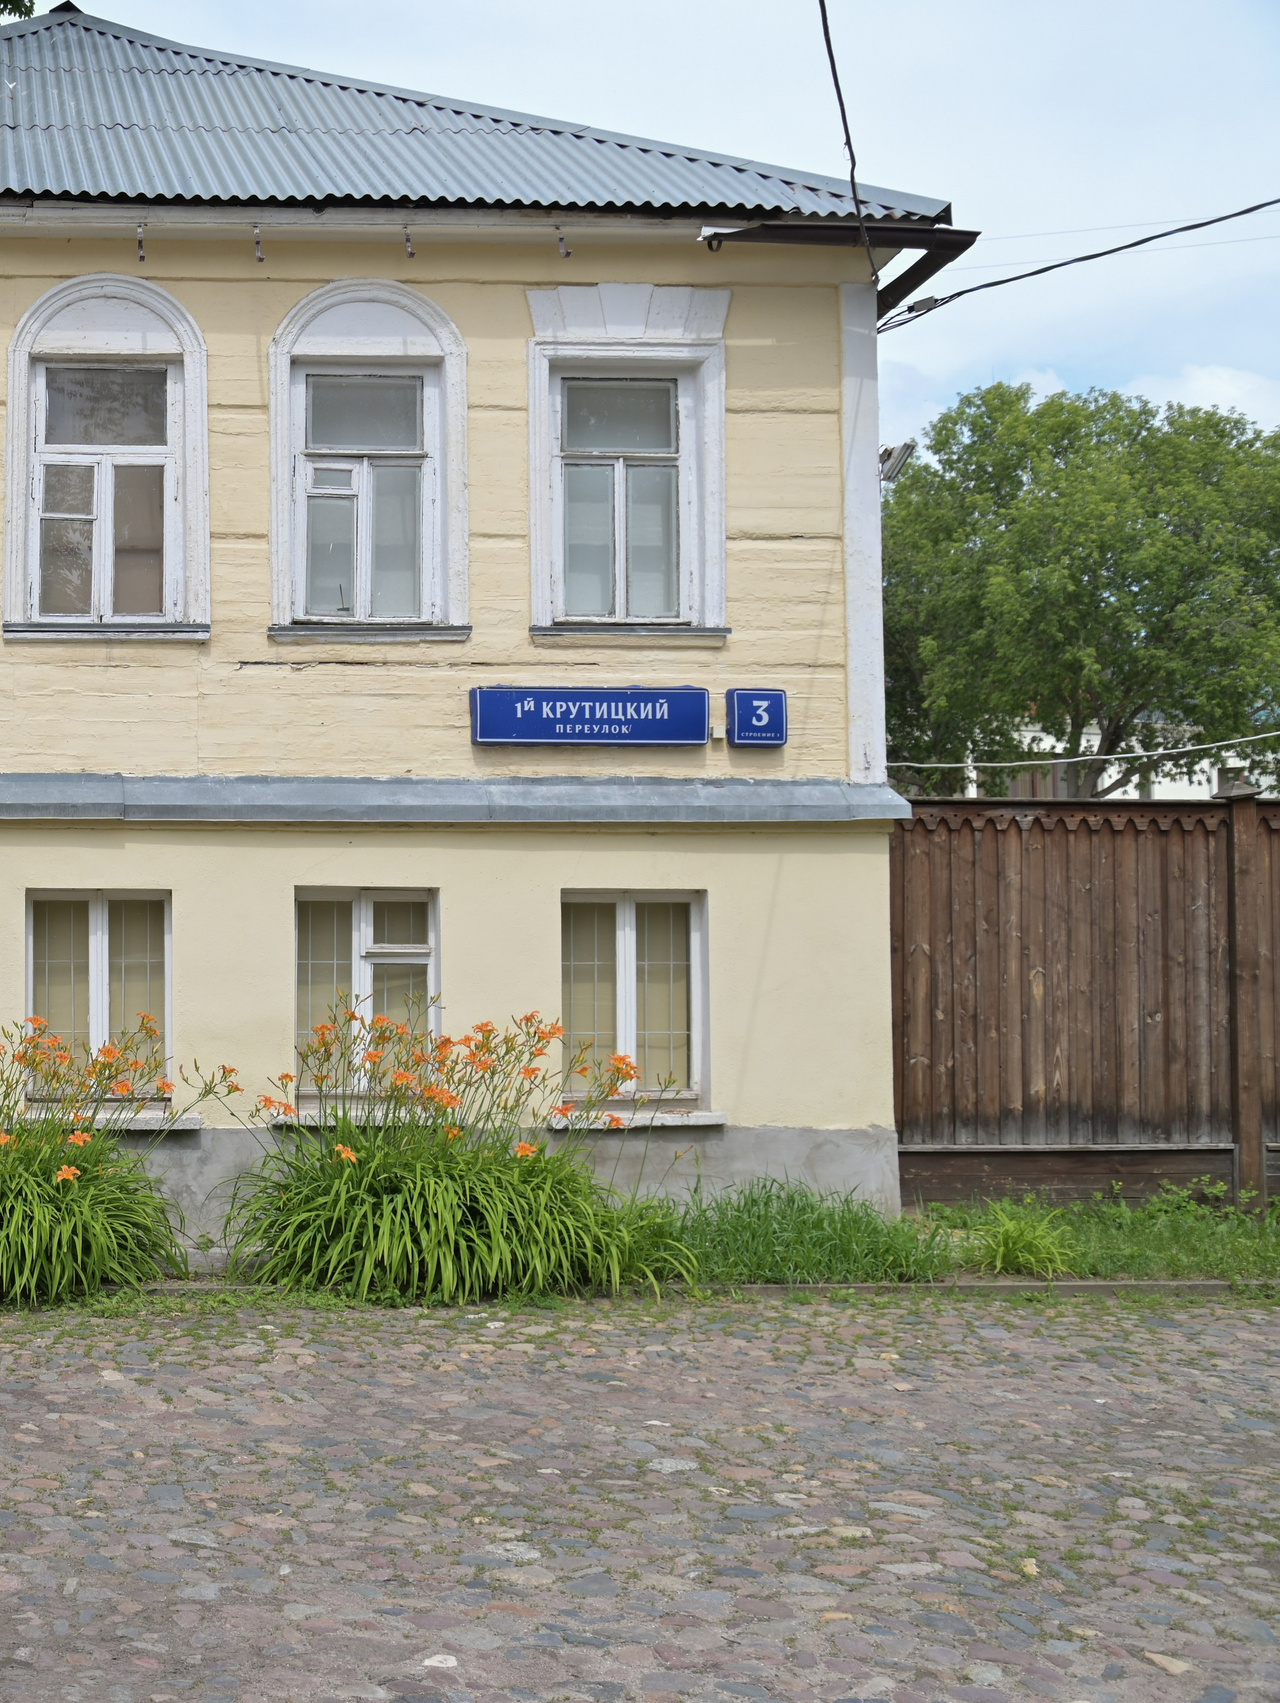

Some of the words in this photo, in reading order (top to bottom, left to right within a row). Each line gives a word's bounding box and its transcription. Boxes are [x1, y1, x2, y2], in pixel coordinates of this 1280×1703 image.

[542, 699, 669, 721] КРУТИЦКИЙ
[751, 700, 770, 727] 3
[555, 724, 629, 734] ПЕРЕУЛОК
